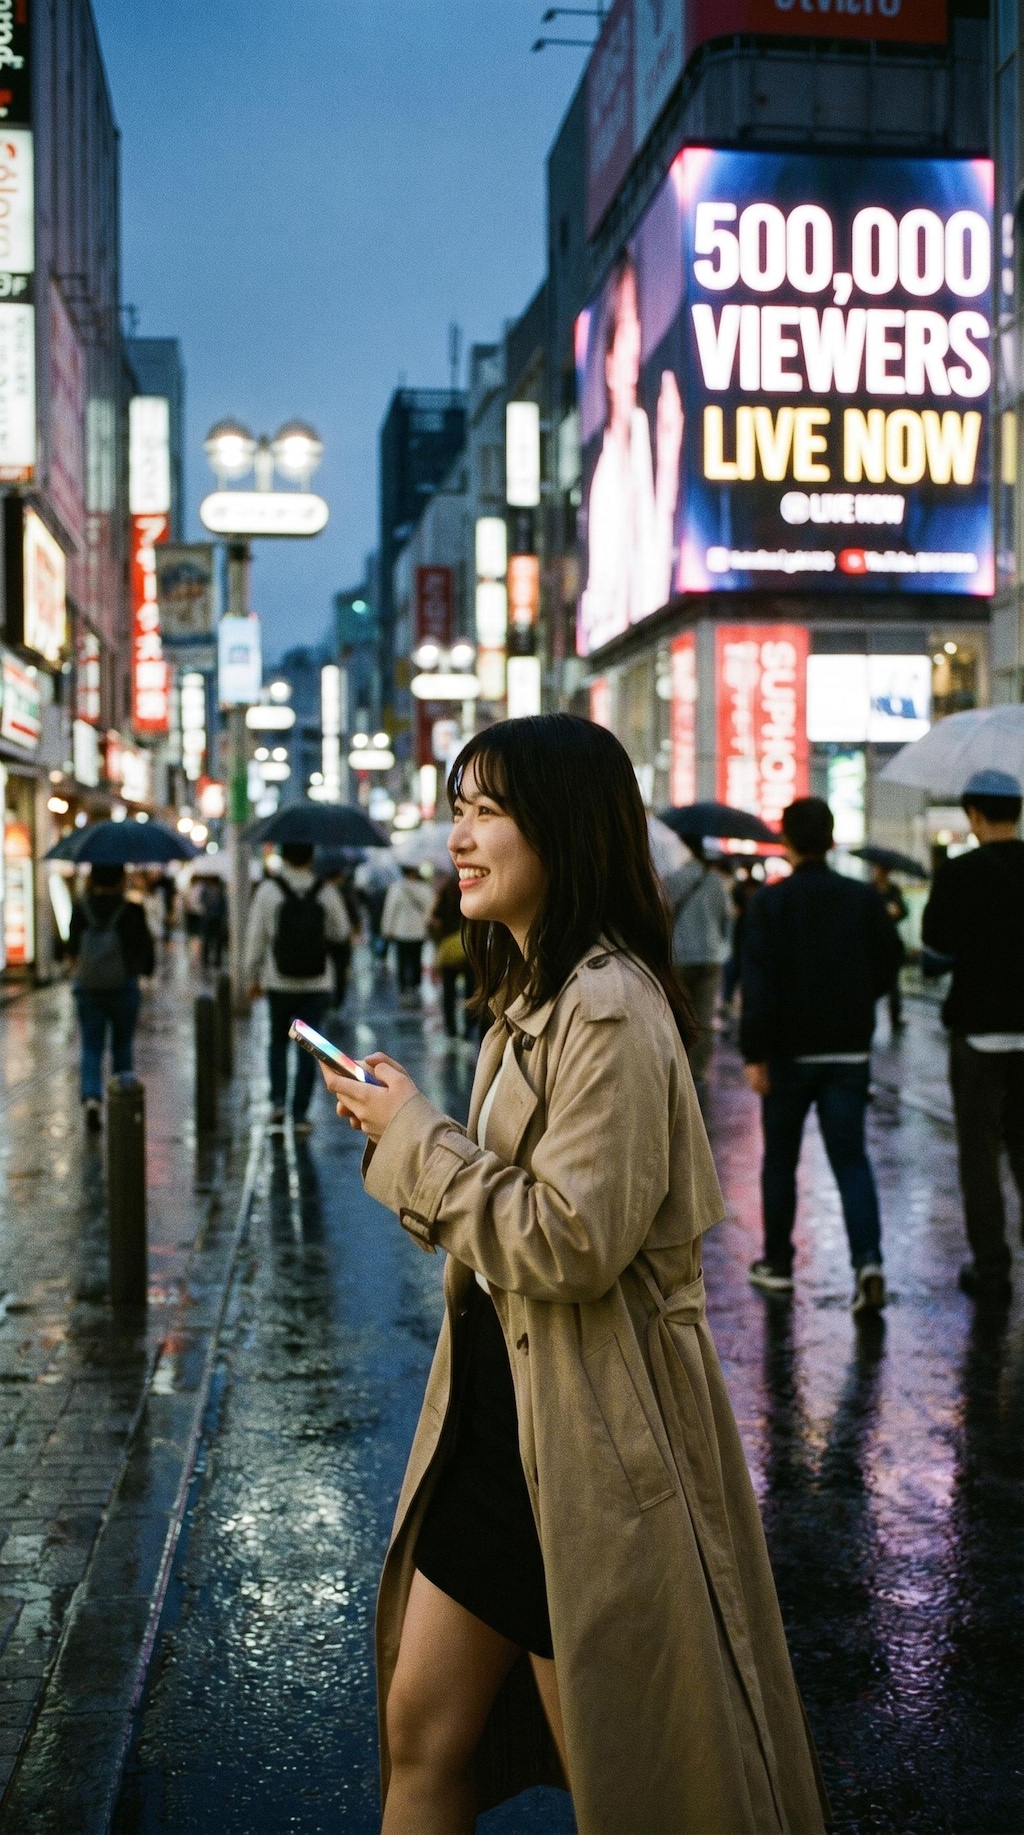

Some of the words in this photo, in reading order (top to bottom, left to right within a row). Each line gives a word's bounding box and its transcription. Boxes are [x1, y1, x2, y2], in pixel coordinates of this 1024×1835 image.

[694, 202, 991, 306] 500,000
[691, 303, 991, 398] VIEWERS
[703, 405, 831, 482] LIVE
[843, 408, 982, 485] NOW
